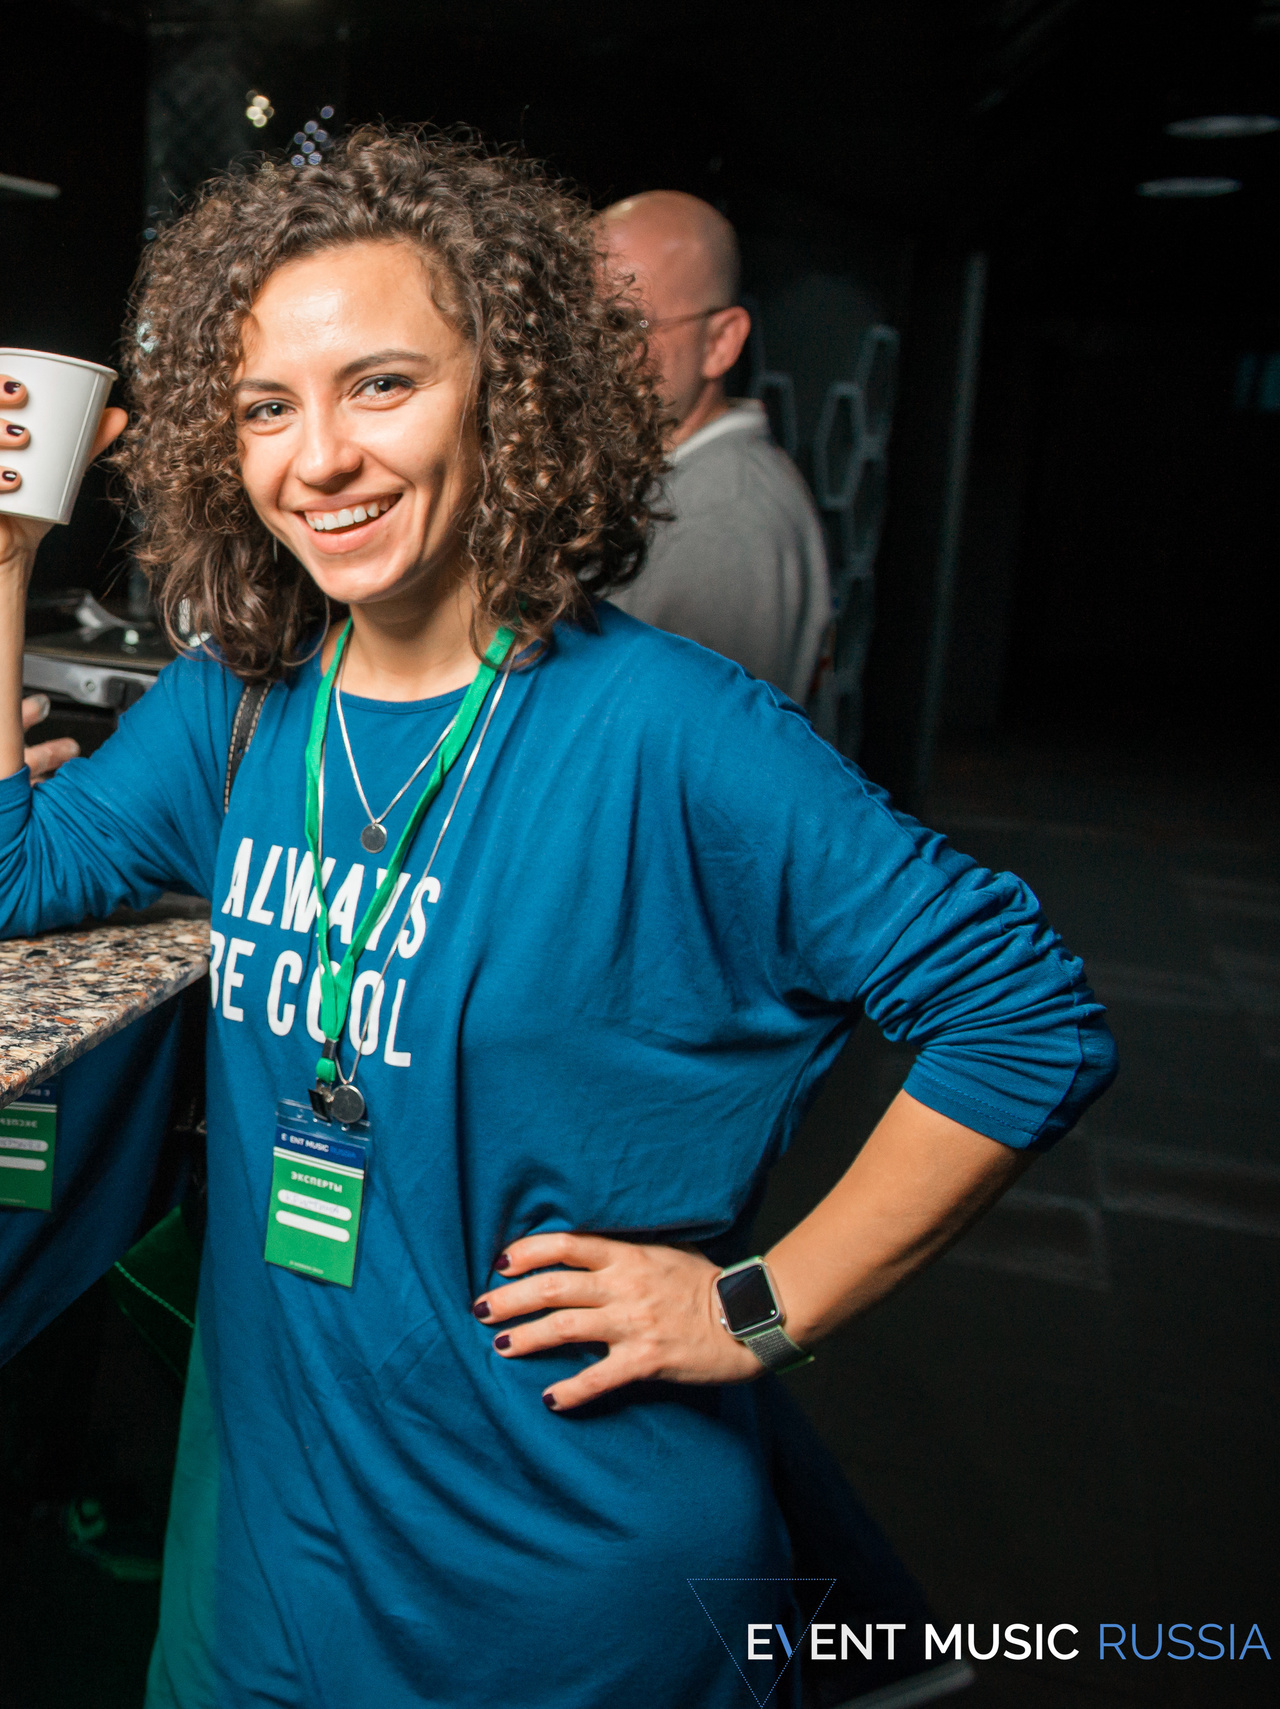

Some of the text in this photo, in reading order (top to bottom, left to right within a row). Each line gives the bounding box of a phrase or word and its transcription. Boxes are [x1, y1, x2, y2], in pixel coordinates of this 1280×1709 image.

[221, 837, 441, 959] ALWAYS
[305, 1140, 329, 1153] MUSIC
[291, 1171, 343, 1193] ЭКСПЕРТЫ
